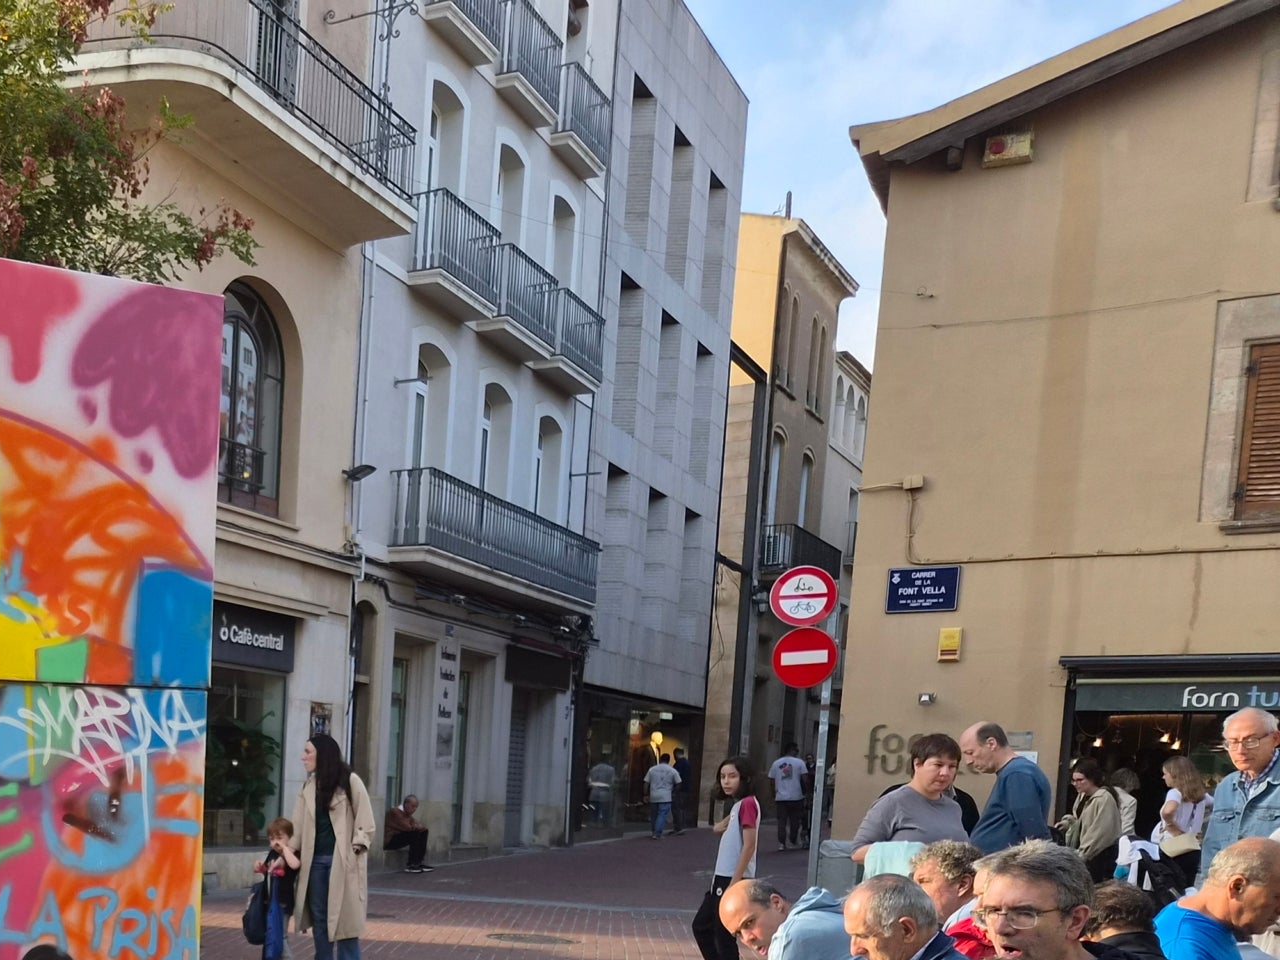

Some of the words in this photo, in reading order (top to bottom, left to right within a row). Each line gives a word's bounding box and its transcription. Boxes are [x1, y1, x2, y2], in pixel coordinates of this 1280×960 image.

[911, 571, 936, 579] CARRER
[898, 587, 918, 596] FONT
[922, 586, 946, 595] VELLA
[252, 633, 284, 651] central
[1182, 685, 1240, 708] forn
[1246, 685, 1280, 707] tu
[869, 724, 924, 754] for
